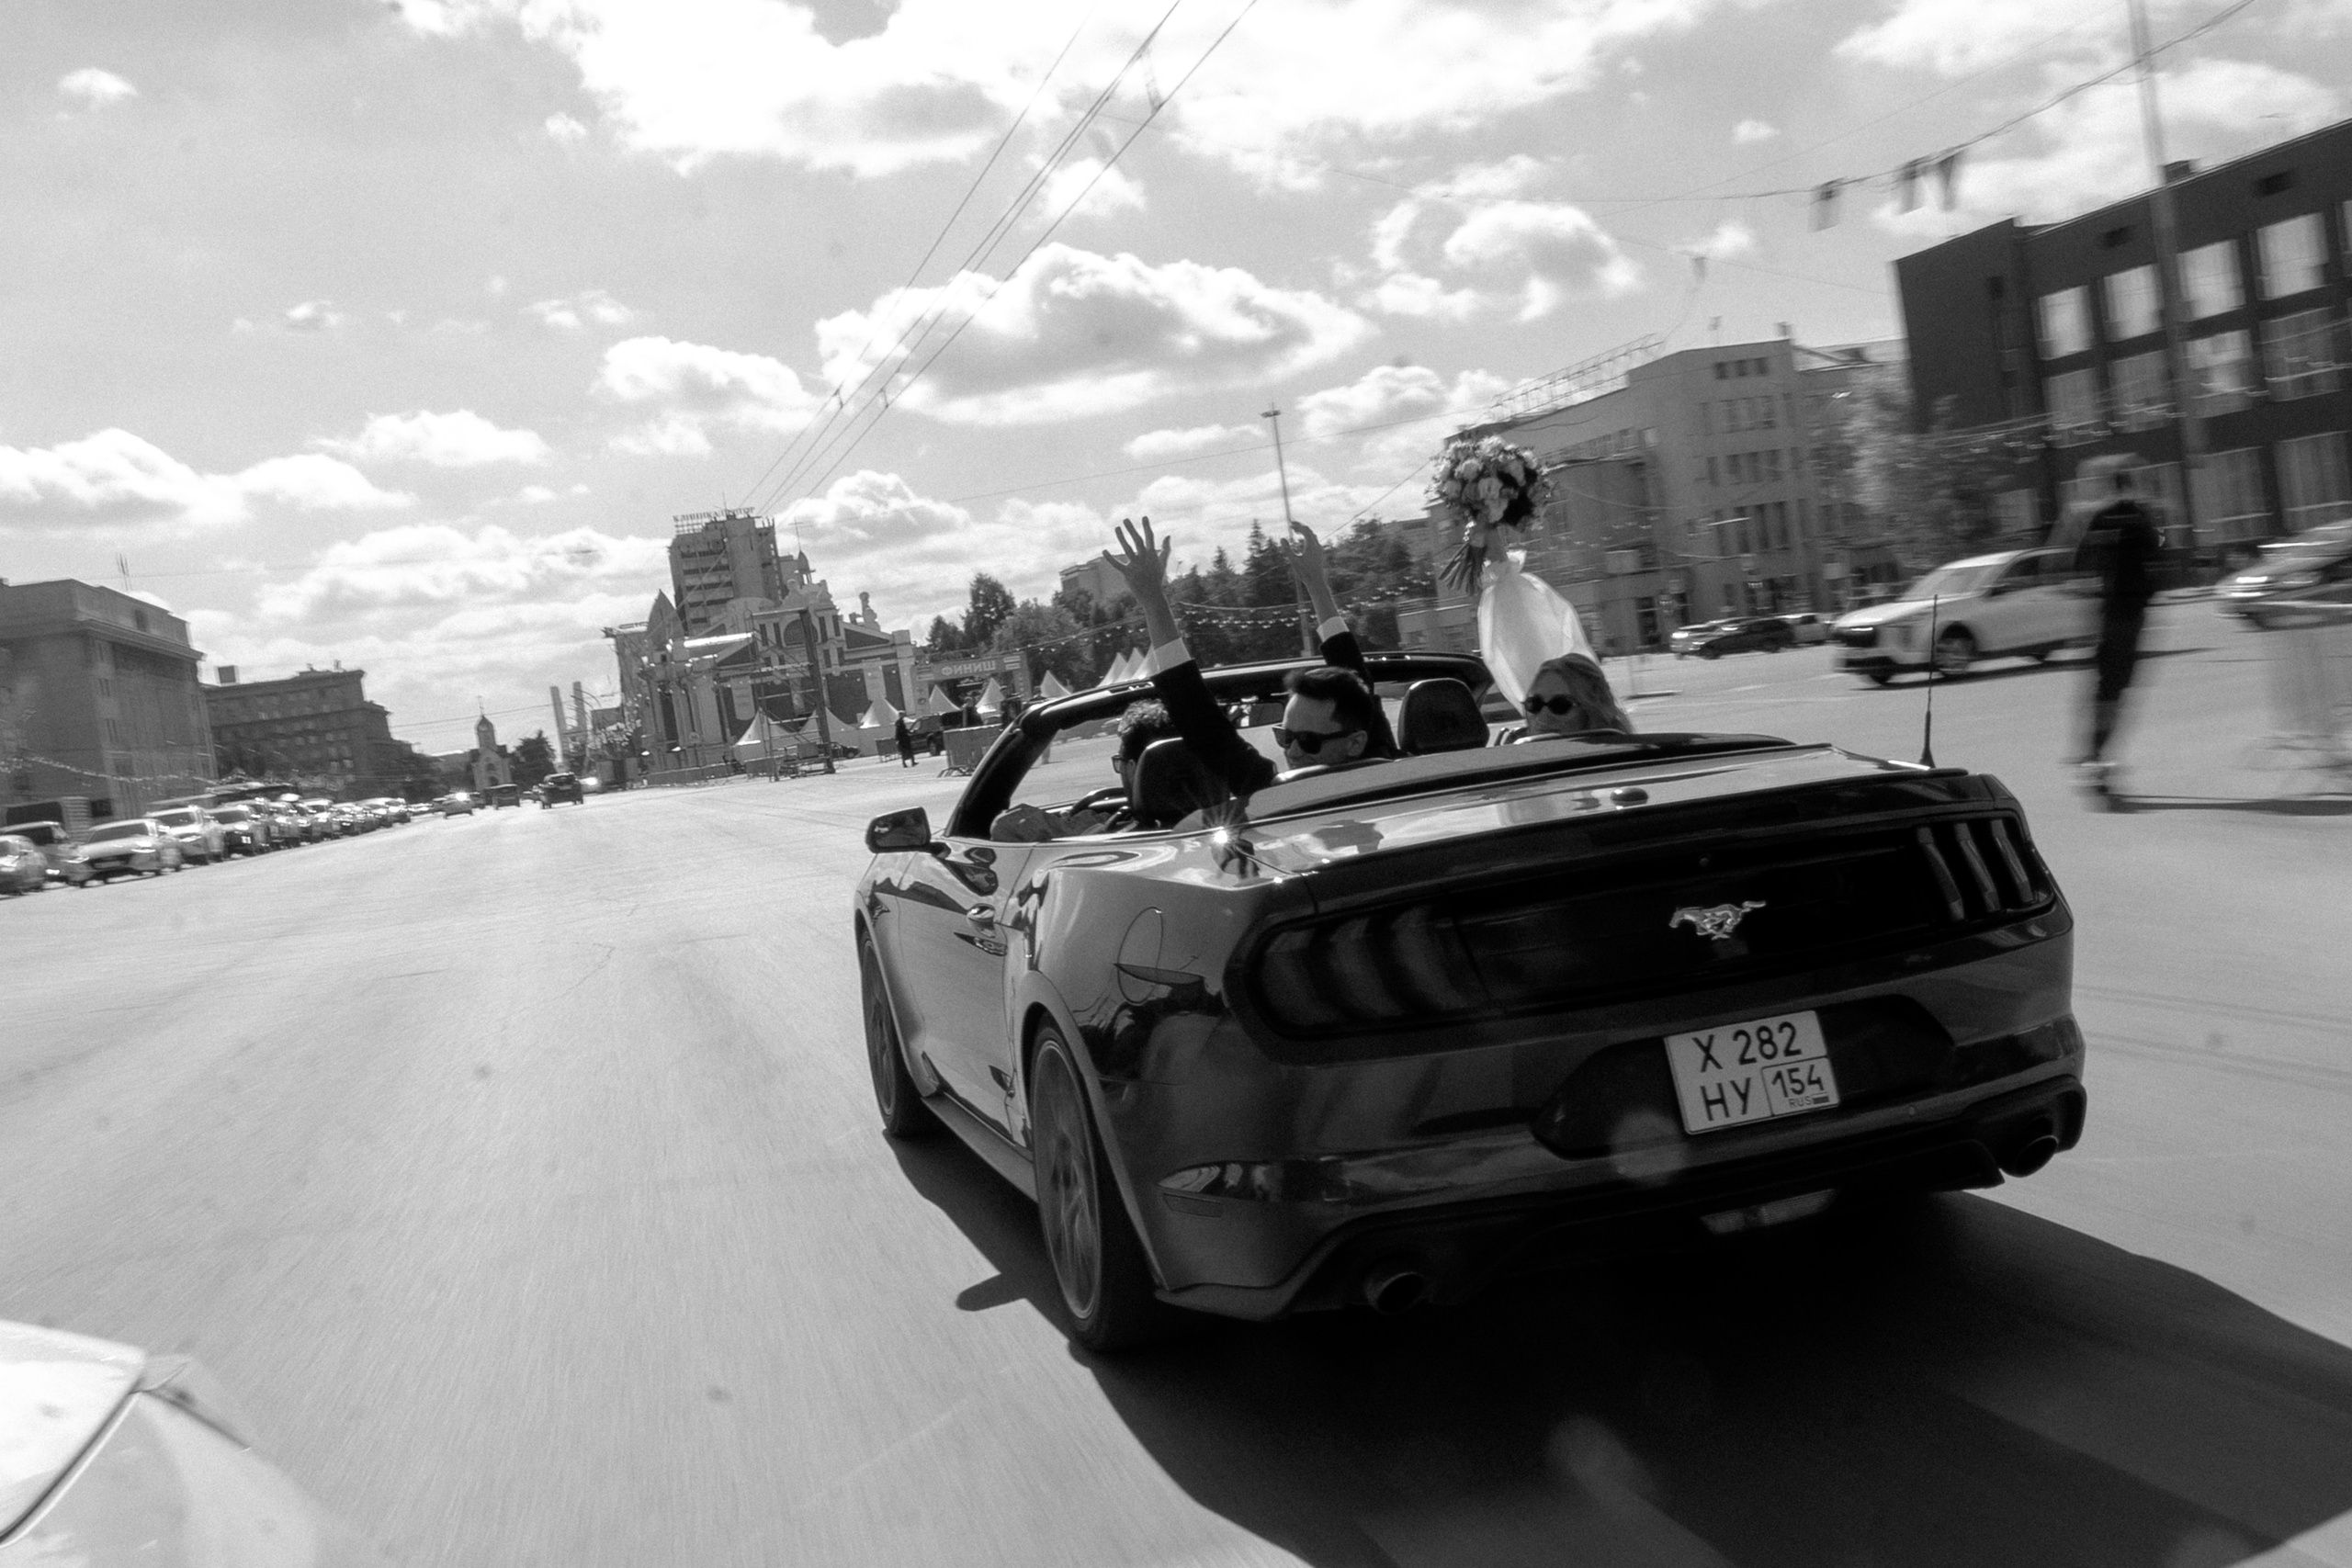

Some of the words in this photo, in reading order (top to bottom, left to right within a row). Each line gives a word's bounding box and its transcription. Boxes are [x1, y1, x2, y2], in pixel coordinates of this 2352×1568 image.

[941, 660, 995, 676] ФИНИШ
[1732, 1021, 1803, 1066] 282
[1771, 1064, 1825, 1099] 154
[1788, 1095, 1812, 1108] RUS
